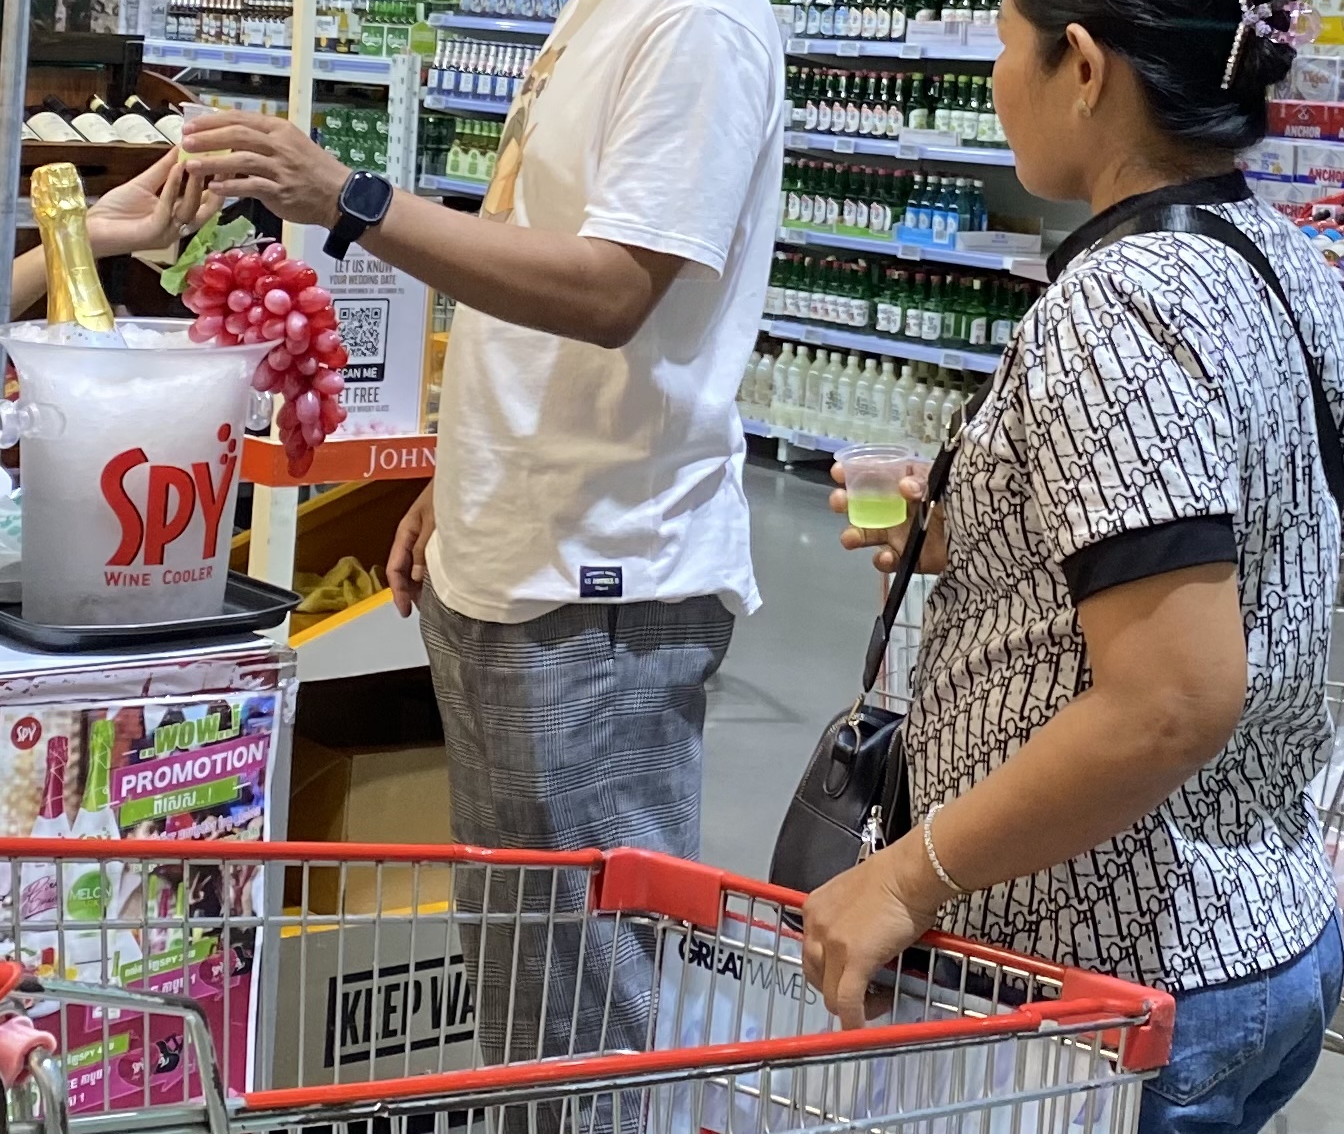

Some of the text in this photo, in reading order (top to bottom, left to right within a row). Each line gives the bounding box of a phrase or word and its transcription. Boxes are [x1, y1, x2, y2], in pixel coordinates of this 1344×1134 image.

[1302, 71, 1330, 88] Tiger
[1284, 126, 1321, 139] ANCHOR
[335, 259, 351, 273] LET
[352, 259, 365, 272] US
[363, 367, 378, 378] ME
[338, 387, 380, 403] ET FREE
[363, 445, 436, 478] JOHN
[100, 447, 237, 566] SPY
[104, 566, 213, 586] WINE COOLER
[15, 724, 37, 743] SPY
[120, 740, 264, 797] PROMOTION
[340, 978, 421, 1047] KEEP
